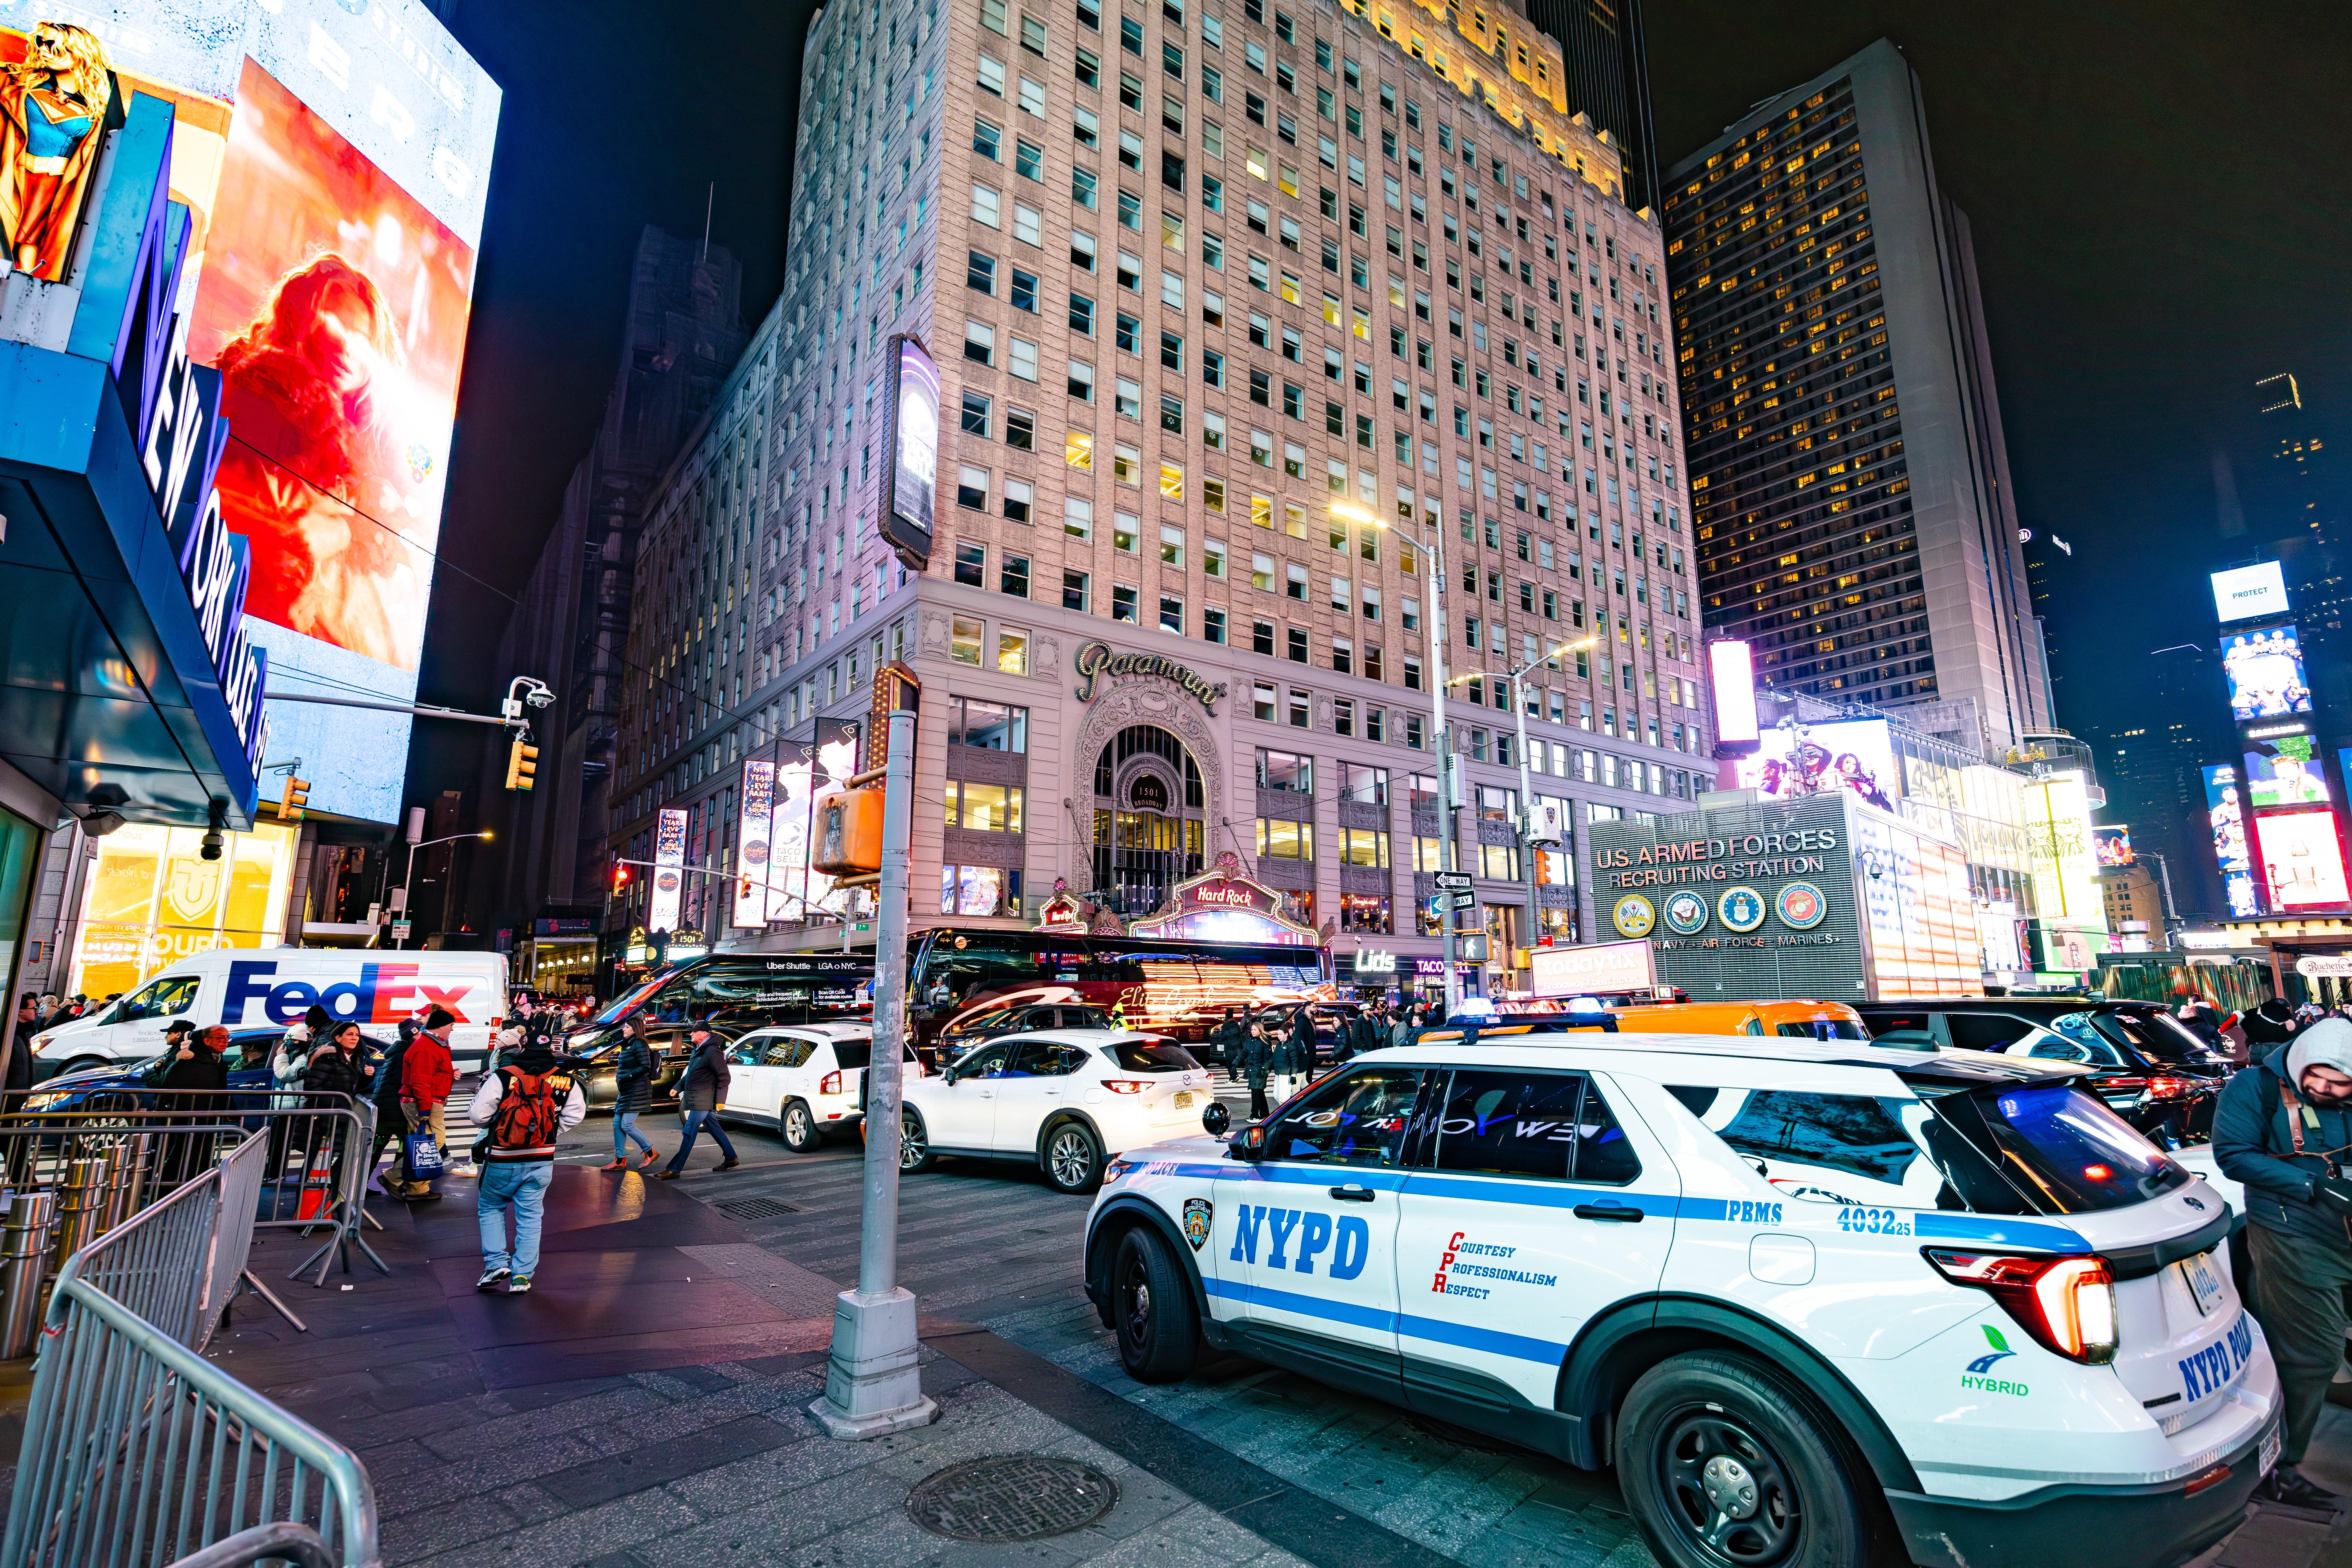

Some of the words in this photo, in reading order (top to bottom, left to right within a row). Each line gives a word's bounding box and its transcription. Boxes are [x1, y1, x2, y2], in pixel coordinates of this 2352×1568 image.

[372, 5, 464, 111] STUDIOS
[2233, 587, 2268, 599] PROTECT
[1076, 641, 1227, 717] Paramount
[2248, 724, 2305, 738] SAMSUNG
[1139, 787, 1158, 797] 1501
[1134, 800, 1163, 810] BROADWAY
[1597, 848, 1634, 869] U.S.
[1638, 838, 1724, 866] ARMED
[1728, 828, 1837, 858] FORCES
[1998, 826, 2024, 855] KING
[1608, 864, 1726, 888] RECRUITING
[1731, 855, 1824, 878] STATION
[1198, 886, 1225, 902] Hard
[1226, 889, 1252, 906] Rock
[1455, 897, 1469, 906] WAY
[1668, 895, 1682, 913] DEPARTMENT
[1721, 891, 1732, 916] DEPARTMENT
[1780, 886, 1799, 907] DEPARTMENT
[1812, 890, 1821, 902] NAVY
[1052, 910, 1065, 921] Hard
[1668, 916, 1678, 928] UNITED
[1696, 913, 1705, 927] AMERICA
[1782, 910, 1792, 922] UNITED
[1805, 916, 1817, 924] MARINE
[1653, 939, 1686, 951] NAVY
[1701, 938, 1719, 949] AIR
[1725, 936, 1765, 948] FORCE
[1778, 933, 1833, 946] MARINES
[1356, 949, 1396, 972] Lids
[1416, 960, 1444, 973] TACO
[1542, 950, 1637, 976] todaytix
[2305, 961, 2345, 973] Buchette
[1543, 978, 1591, 991] Broadway's
[1592, 977, 1612, 987] best
[1612, 975, 1639, 984] ticket
[220, 961, 475, 1026] FedEx
[1117, 985, 1161, 1007] Elite
[1165, 987, 1215, 1007] Coach
[545, 1075, 571, 1091] OWL
[1138, 1161, 1178, 1177] POLICE
[1185, 1205, 1211, 1216] DEPARTMENT
[1728, 1200, 1782, 1226] PBMS
[1230, 1203, 1370, 1281] NYPD
[2178, 1341, 2230, 1403] NYPD
[1961, 1375, 2029, 1397] HYBRID
